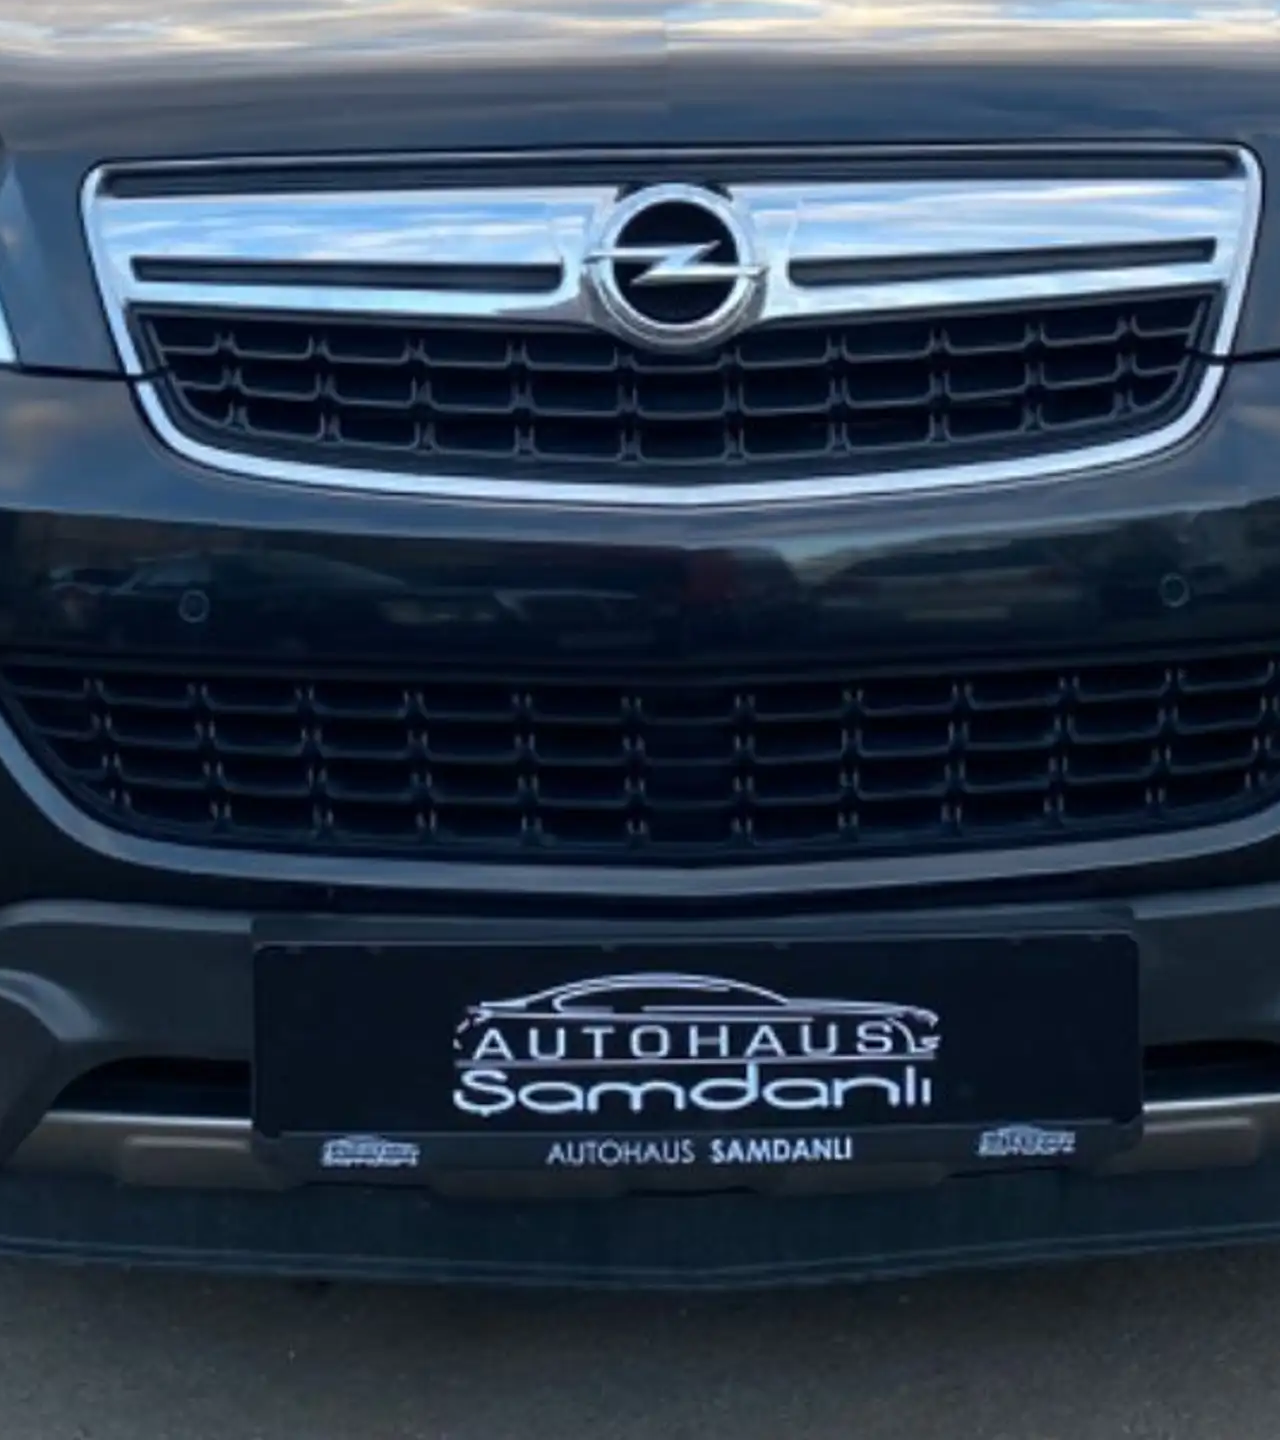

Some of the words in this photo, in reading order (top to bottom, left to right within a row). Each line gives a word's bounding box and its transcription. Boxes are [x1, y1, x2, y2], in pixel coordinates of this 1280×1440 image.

[472, 1020, 894, 1060] AUTOHAUS
[546, 1139, 696, 1165] AUTOHAUS
[710, 1136, 853, 1164] SAMDANLI
